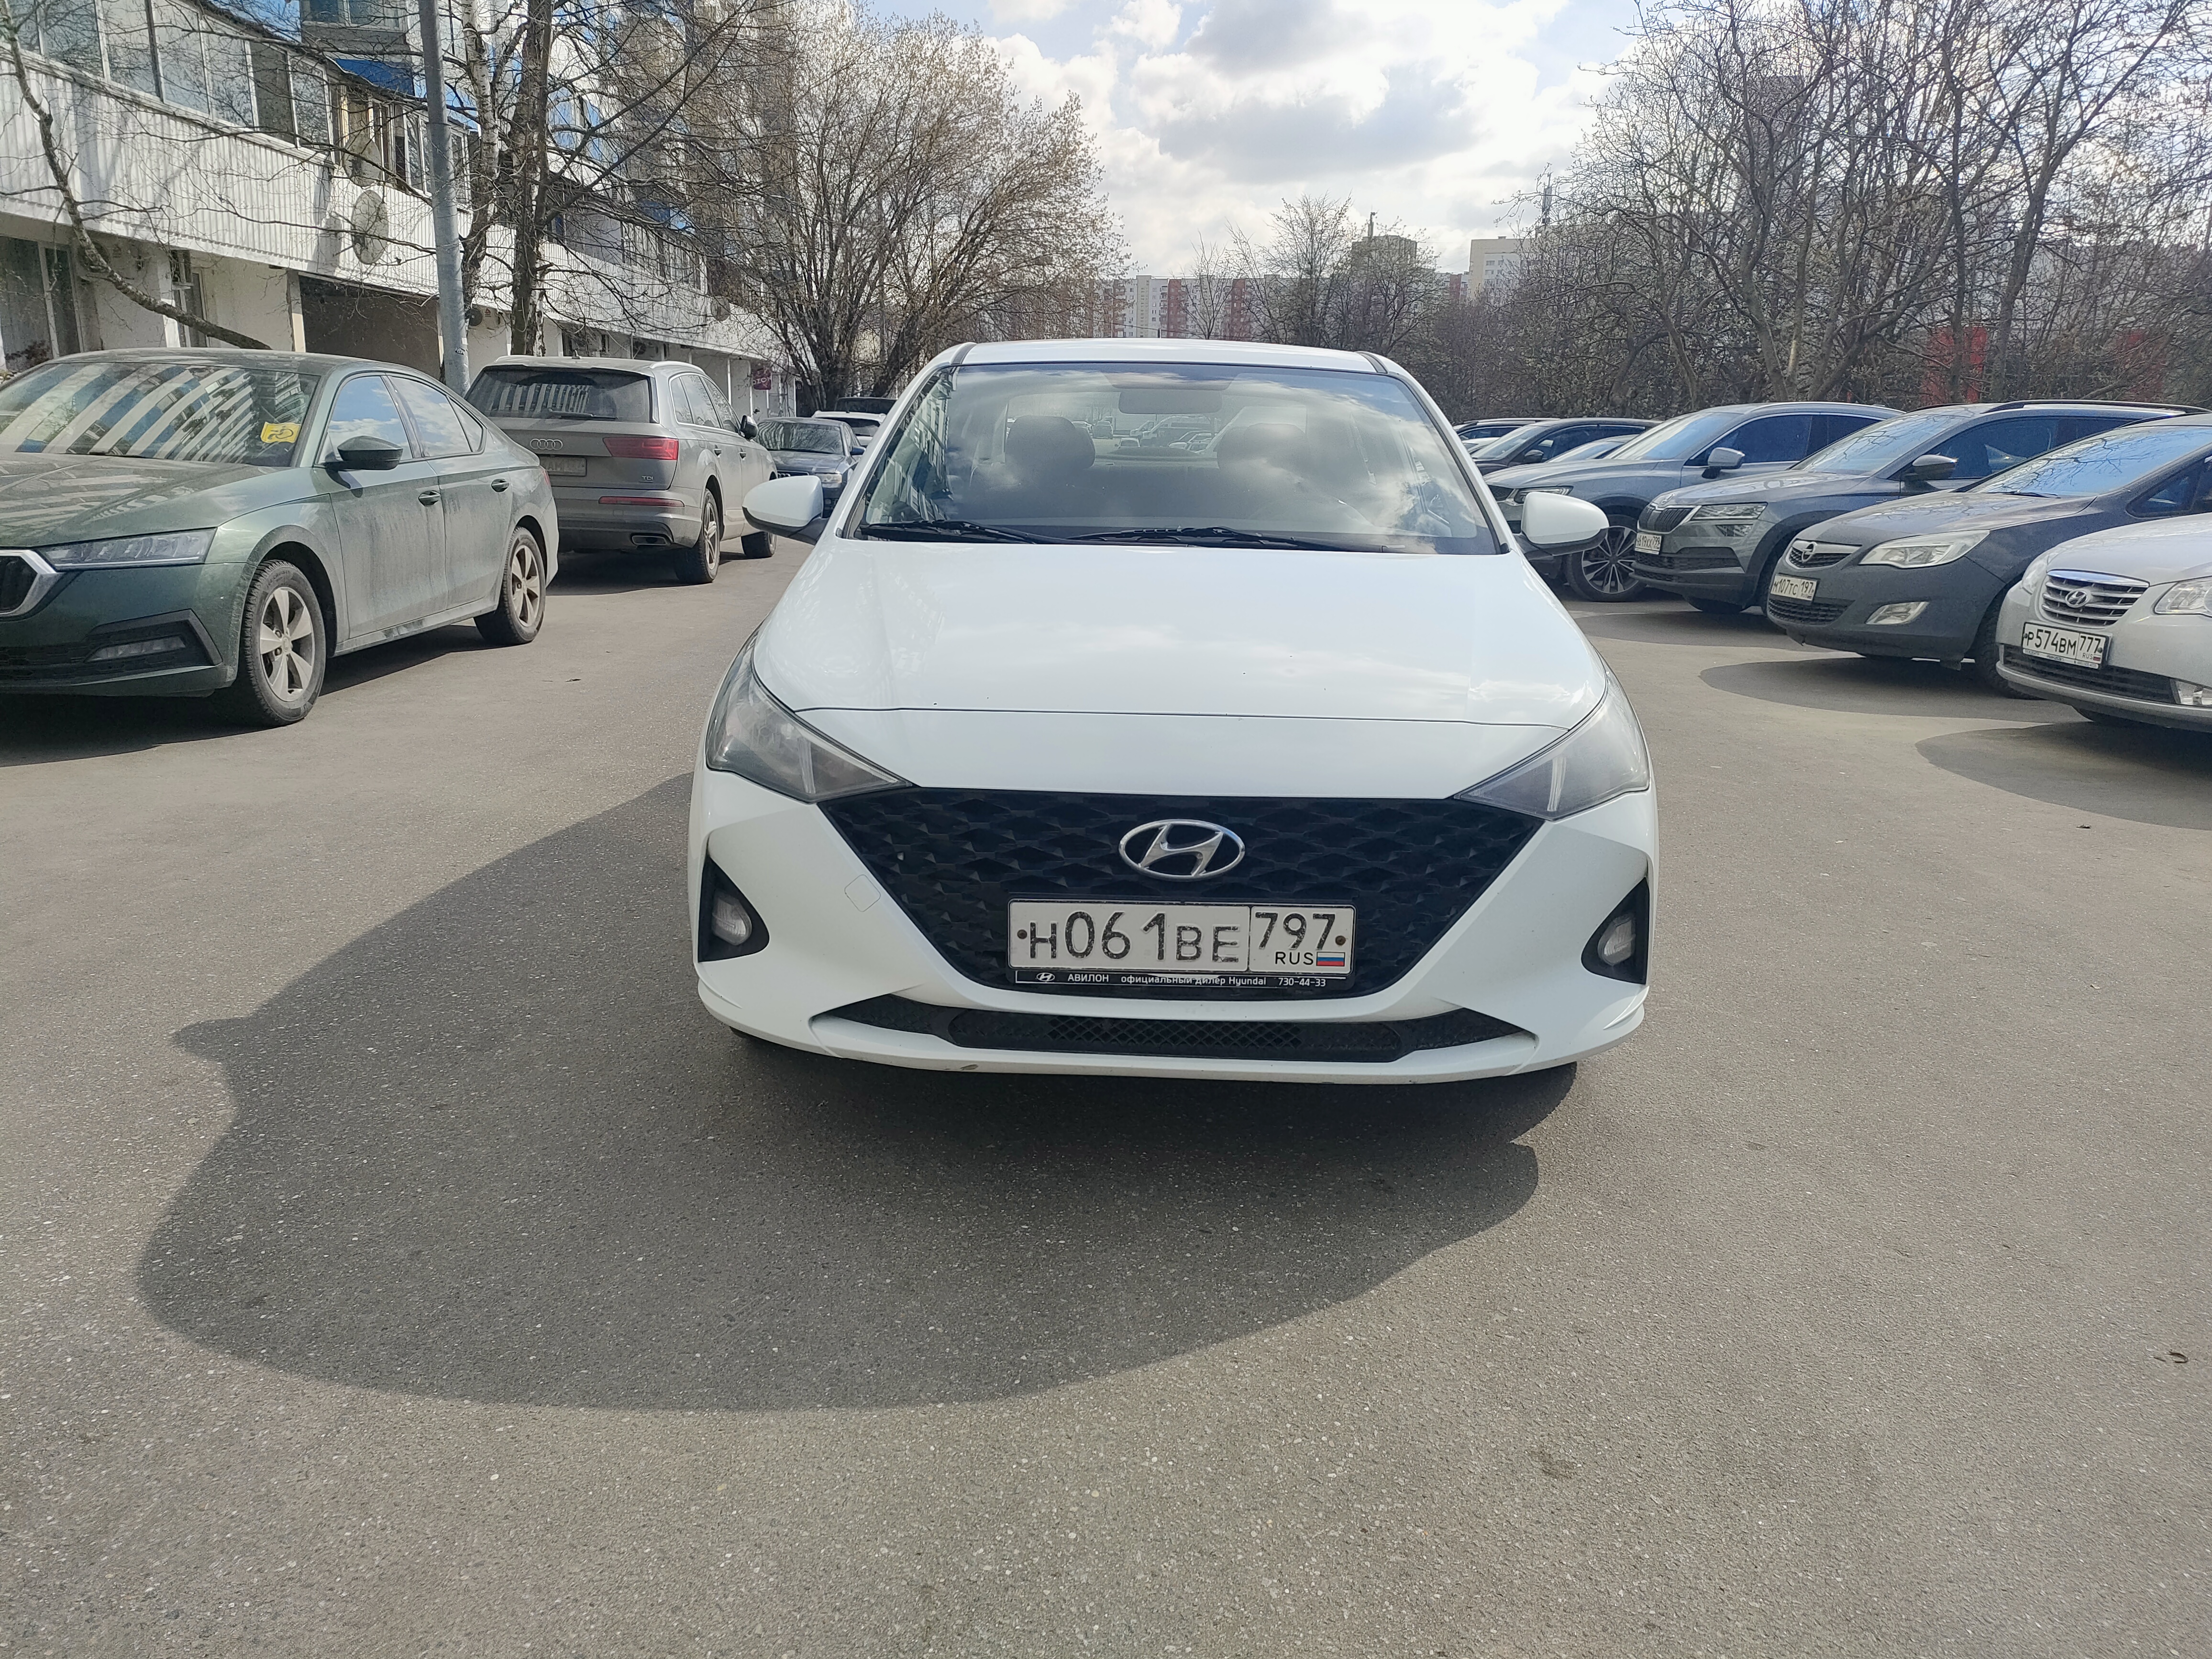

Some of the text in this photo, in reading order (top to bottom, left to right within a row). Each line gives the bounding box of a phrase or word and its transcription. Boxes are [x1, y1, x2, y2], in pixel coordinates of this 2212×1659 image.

[1801, 581, 1814, 594] 197
[2027, 629, 2101, 656] Р574ВМ 777
[1030, 911, 1336, 962] Н061ВЕ 797
[1275, 951, 1314, 965] RUS
[1067, 973, 1326, 987] АВИЛОН официальный дилер Hyundai 730-44-33
